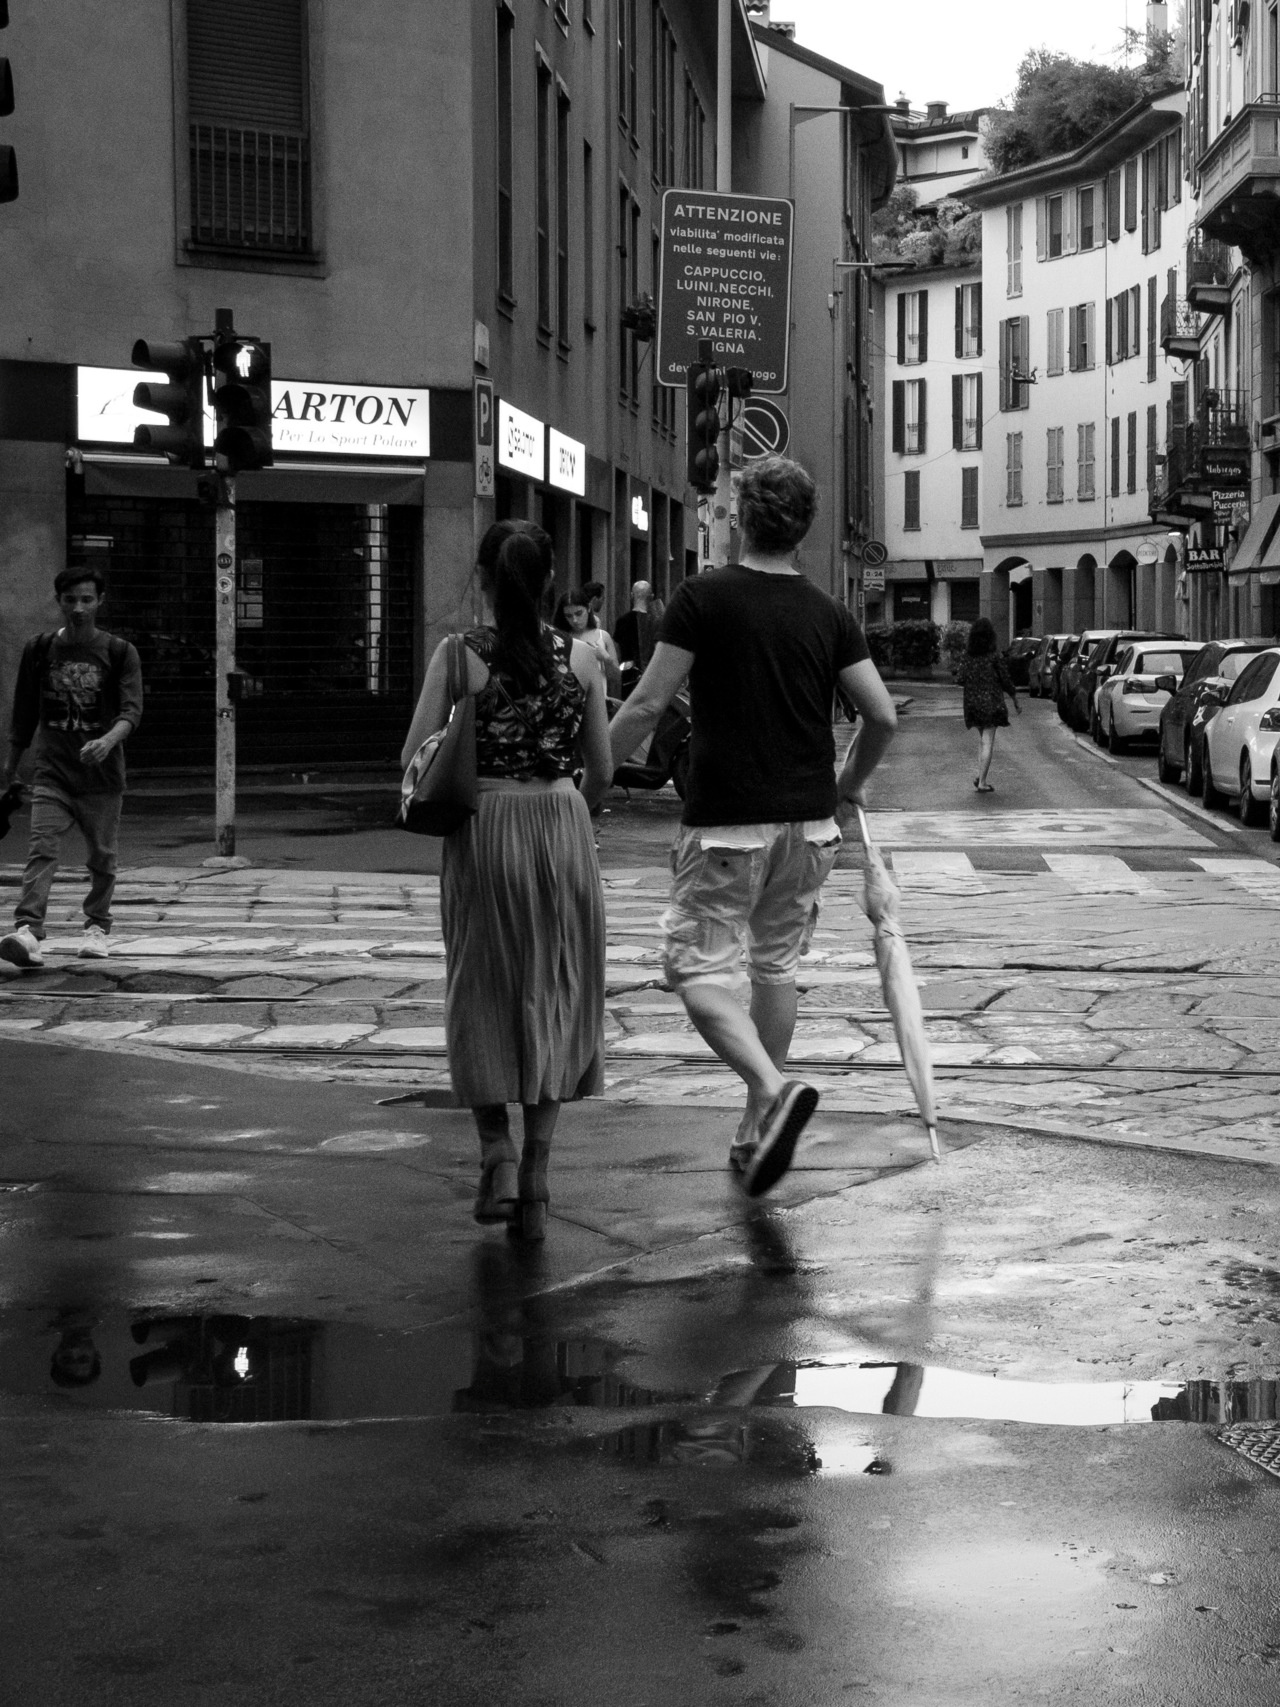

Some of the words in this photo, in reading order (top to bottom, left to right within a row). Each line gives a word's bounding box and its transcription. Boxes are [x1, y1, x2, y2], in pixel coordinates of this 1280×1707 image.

[674, 204, 782, 225] ATTENZIONE
[723, 232, 785, 246] modificata
[673, 244, 703, 254] nelle
[706, 246, 756, 259] seguenti
[687, 310, 715, 322] SAN
[723, 312, 746, 324] PIO
[712, 341, 745, 354] IGNA
[272, 390, 417, 427] ARTON
[480, 392, 489, 438] P
[279, 429, 304, 442] Per
[308, 430, 326, 443] Lo
[331, 432, 368, 447] Sport
[372, 434, 418, 448] Polare
[1212, 490, 1246, 501] Pizzeria
[1188, 549, 1221, 561] BAR
